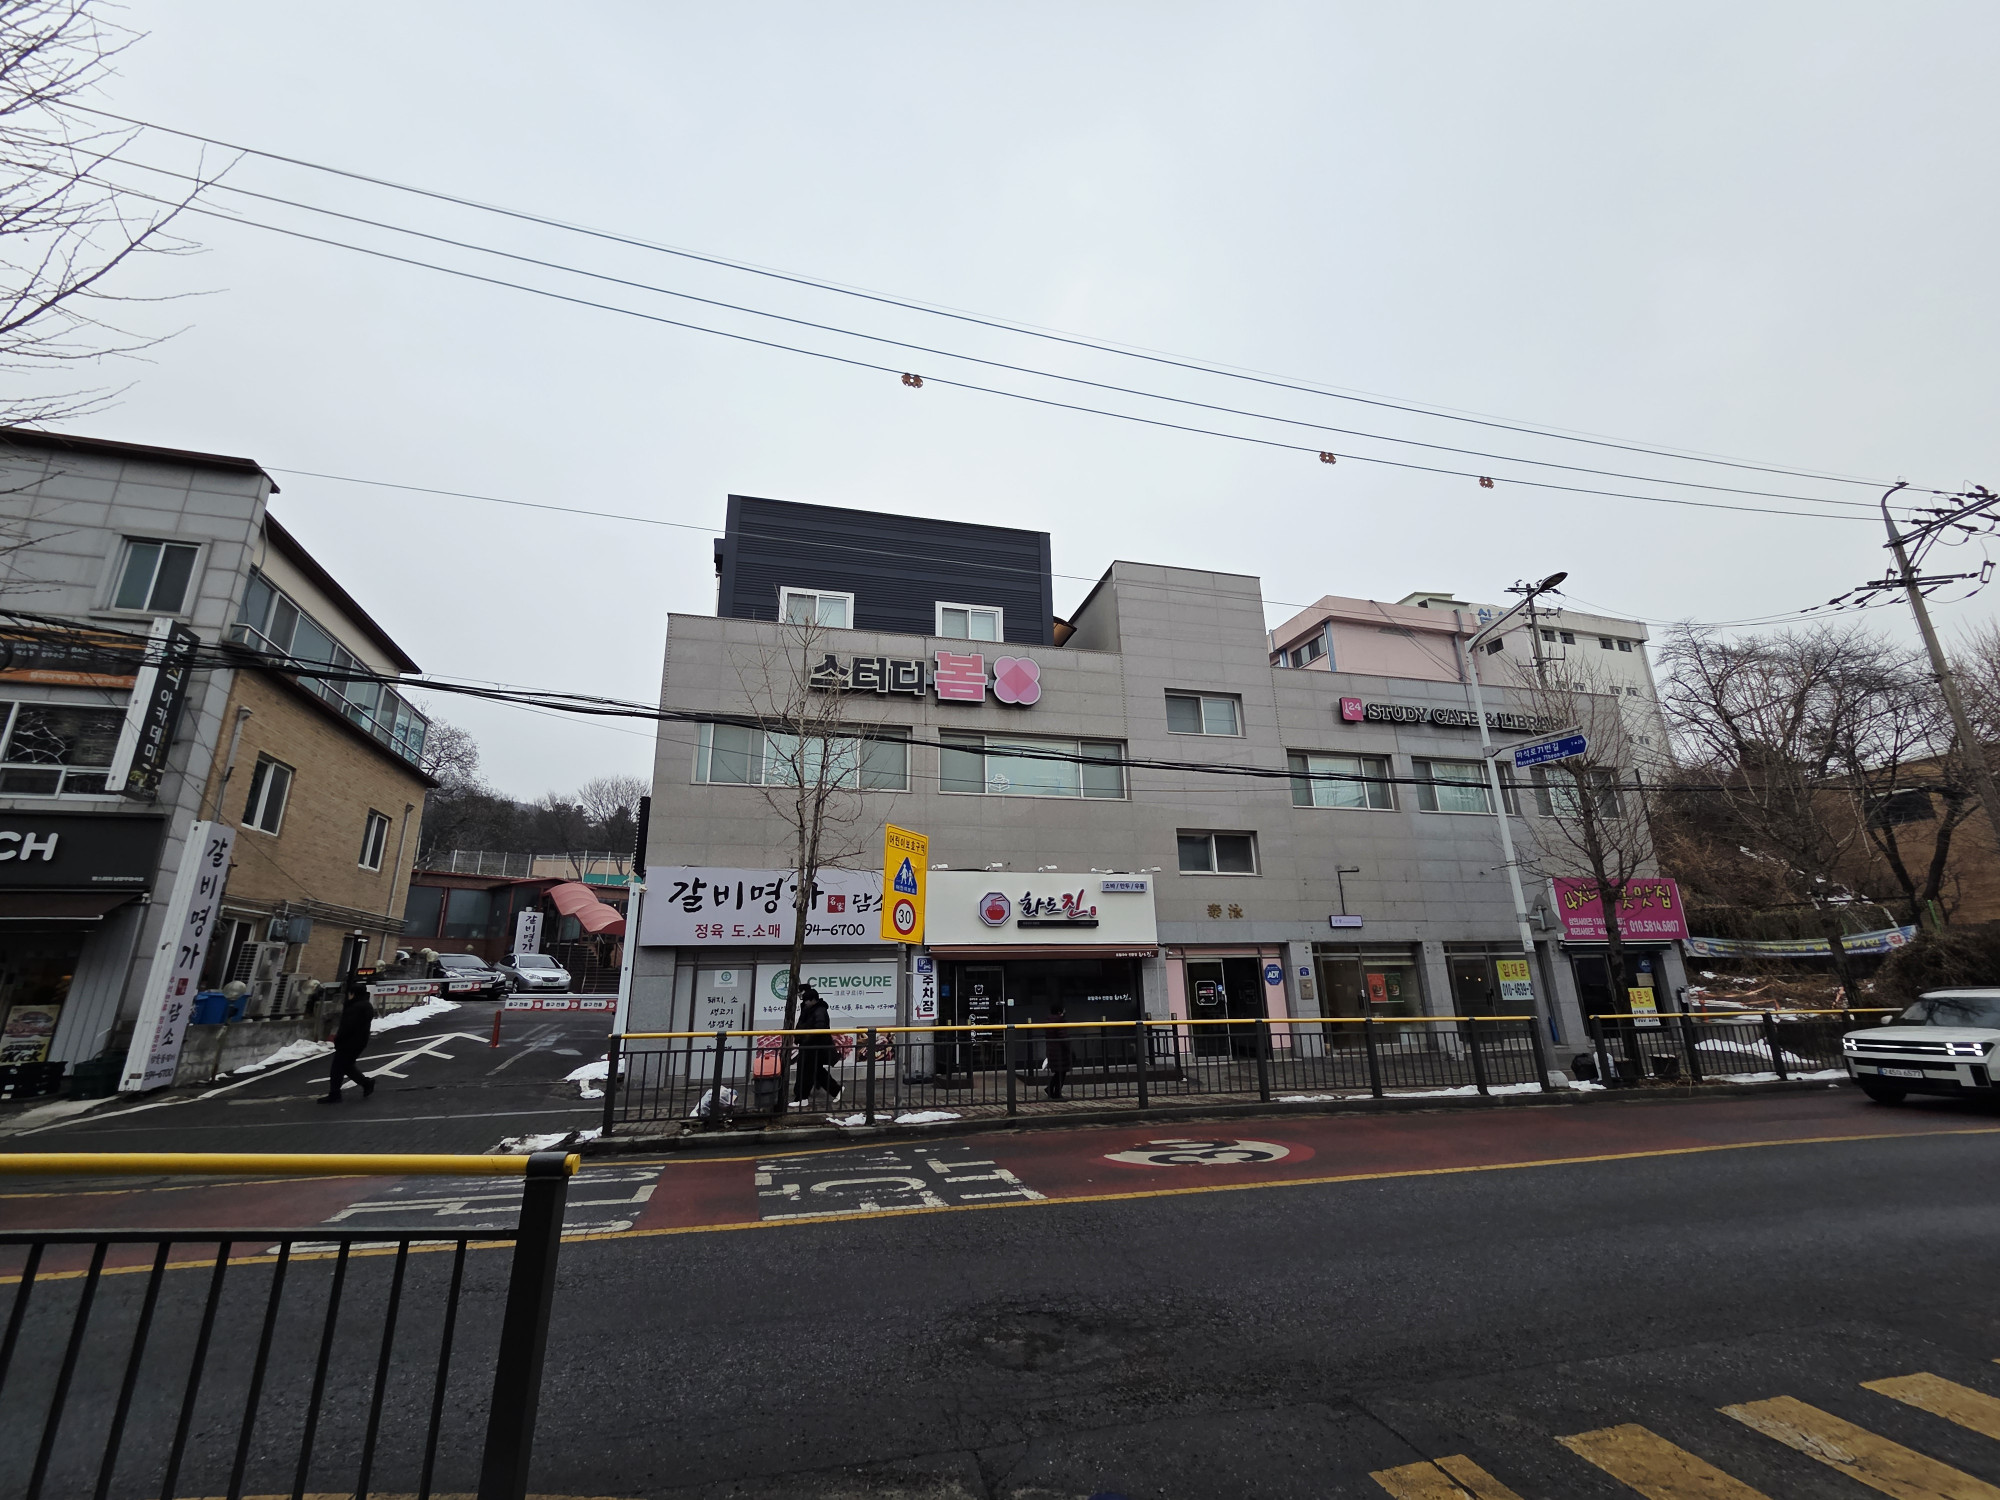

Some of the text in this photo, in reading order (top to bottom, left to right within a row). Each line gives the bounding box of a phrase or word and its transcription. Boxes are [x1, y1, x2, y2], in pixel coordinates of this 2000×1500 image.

[1366, 703, 1428, 723] STUDY
[1432, 708, 1481, 726] CAFE
[145, 689, 173, 763] 아카데미
[1516, 742, 1560, 758] 마석로71번길
[1517, 756, 1542, 767] Maseok-ro
[889, 834, 926, 854] 어린이보호구역
[180, 838, 228, 970] 갈비명가
[1019, 889, 1088, 917] 화도진
[898, 909, 912, 924] 30
[522, 915, 538, 951] 갈비명가
[695, 923, 781, 939] 정육 도.소매
[803, 923, 866, 937] 94-6700
[1267, 970, 1280, 979] ADT
[1503, 963, 1528, 978] 임대문
[807, 976, 892, 988] CREWGURE
[731, 996, 739, 1004] 소
[922, 975, 934, 1012] 주차장
[1628, 990, 1651, 1004] 대문의
[709, 1008, 734, 1016] 생고기
[161, 1002, 183, 1047] 담소
